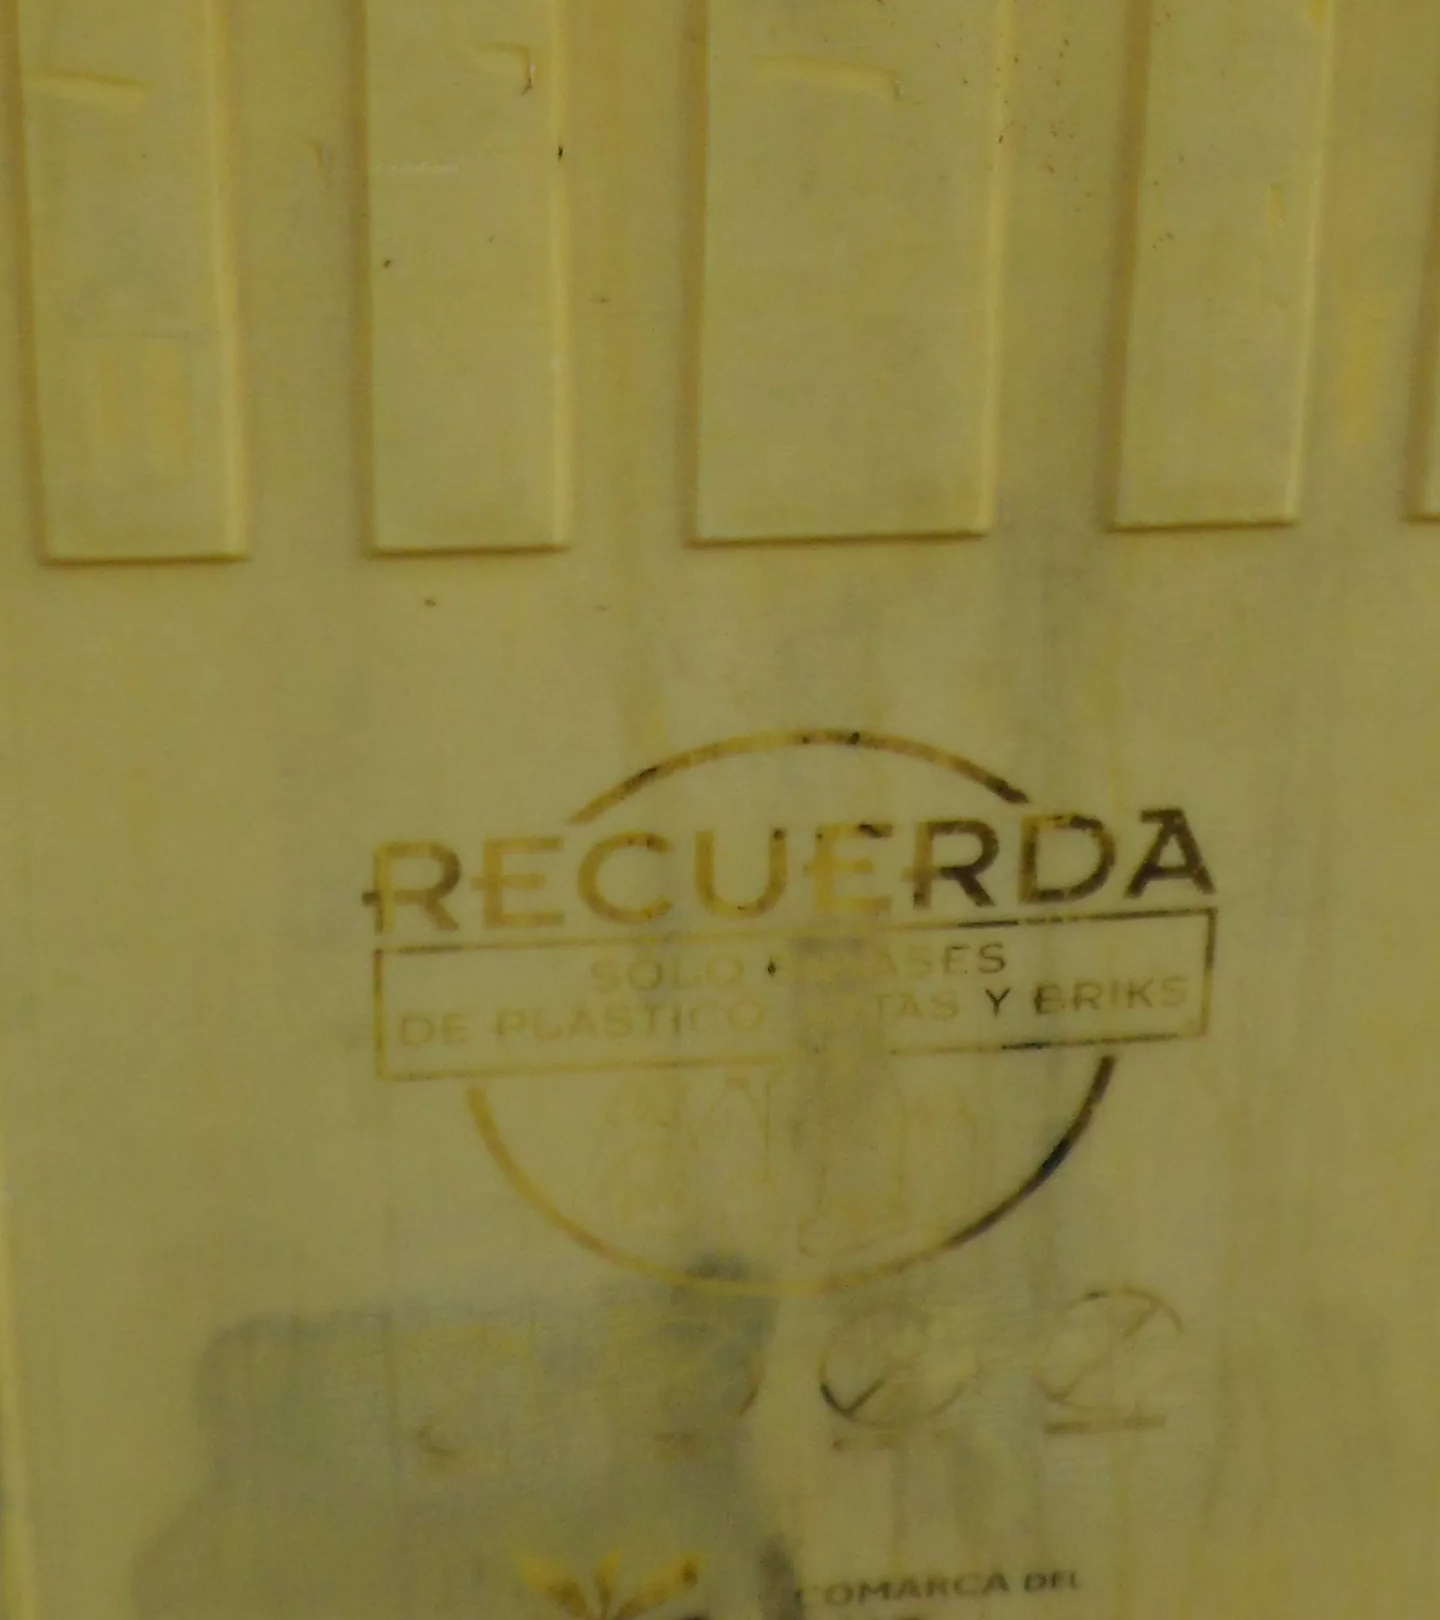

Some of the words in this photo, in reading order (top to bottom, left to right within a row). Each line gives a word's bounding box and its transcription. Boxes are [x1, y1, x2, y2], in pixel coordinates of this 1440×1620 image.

[362, 808, 1216, 933] RECUERDA
[398, 1011, 468, 1048] DE
[985, 986, 1010, 1017] Y
[1034, 976, 1188, 1016] BRIKS
